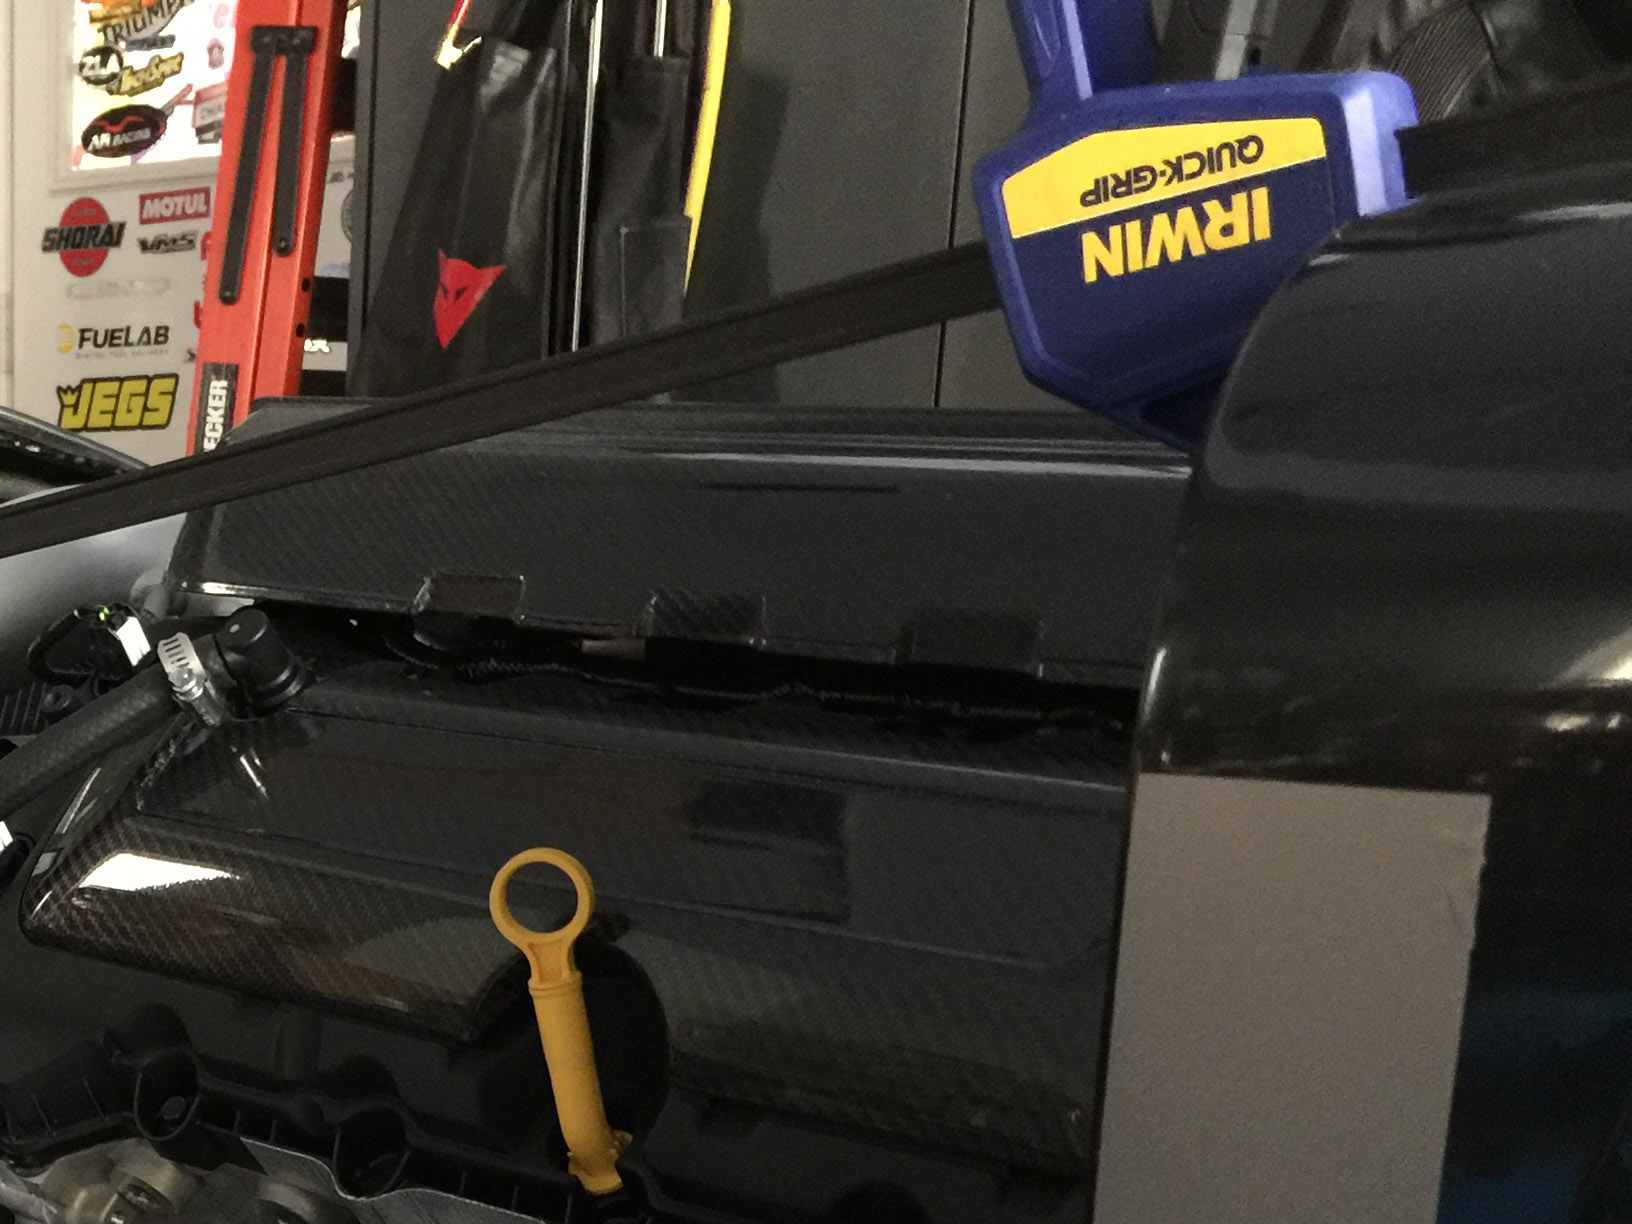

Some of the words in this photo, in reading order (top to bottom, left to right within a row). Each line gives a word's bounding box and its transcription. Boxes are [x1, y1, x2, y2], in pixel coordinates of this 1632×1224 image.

[1080, 134, 1265, 207] QUICK-GRIP
[142, 192, 208, 219] MOTUL
[1081, 186, 1272, 284] IRWIN
[41, 221, 127, 253] SHORAI
[78, 325, 170, 349] FUELAB
[58, 373, 179, 432] JEGS
[203, 379, 229, 452] ECKER
